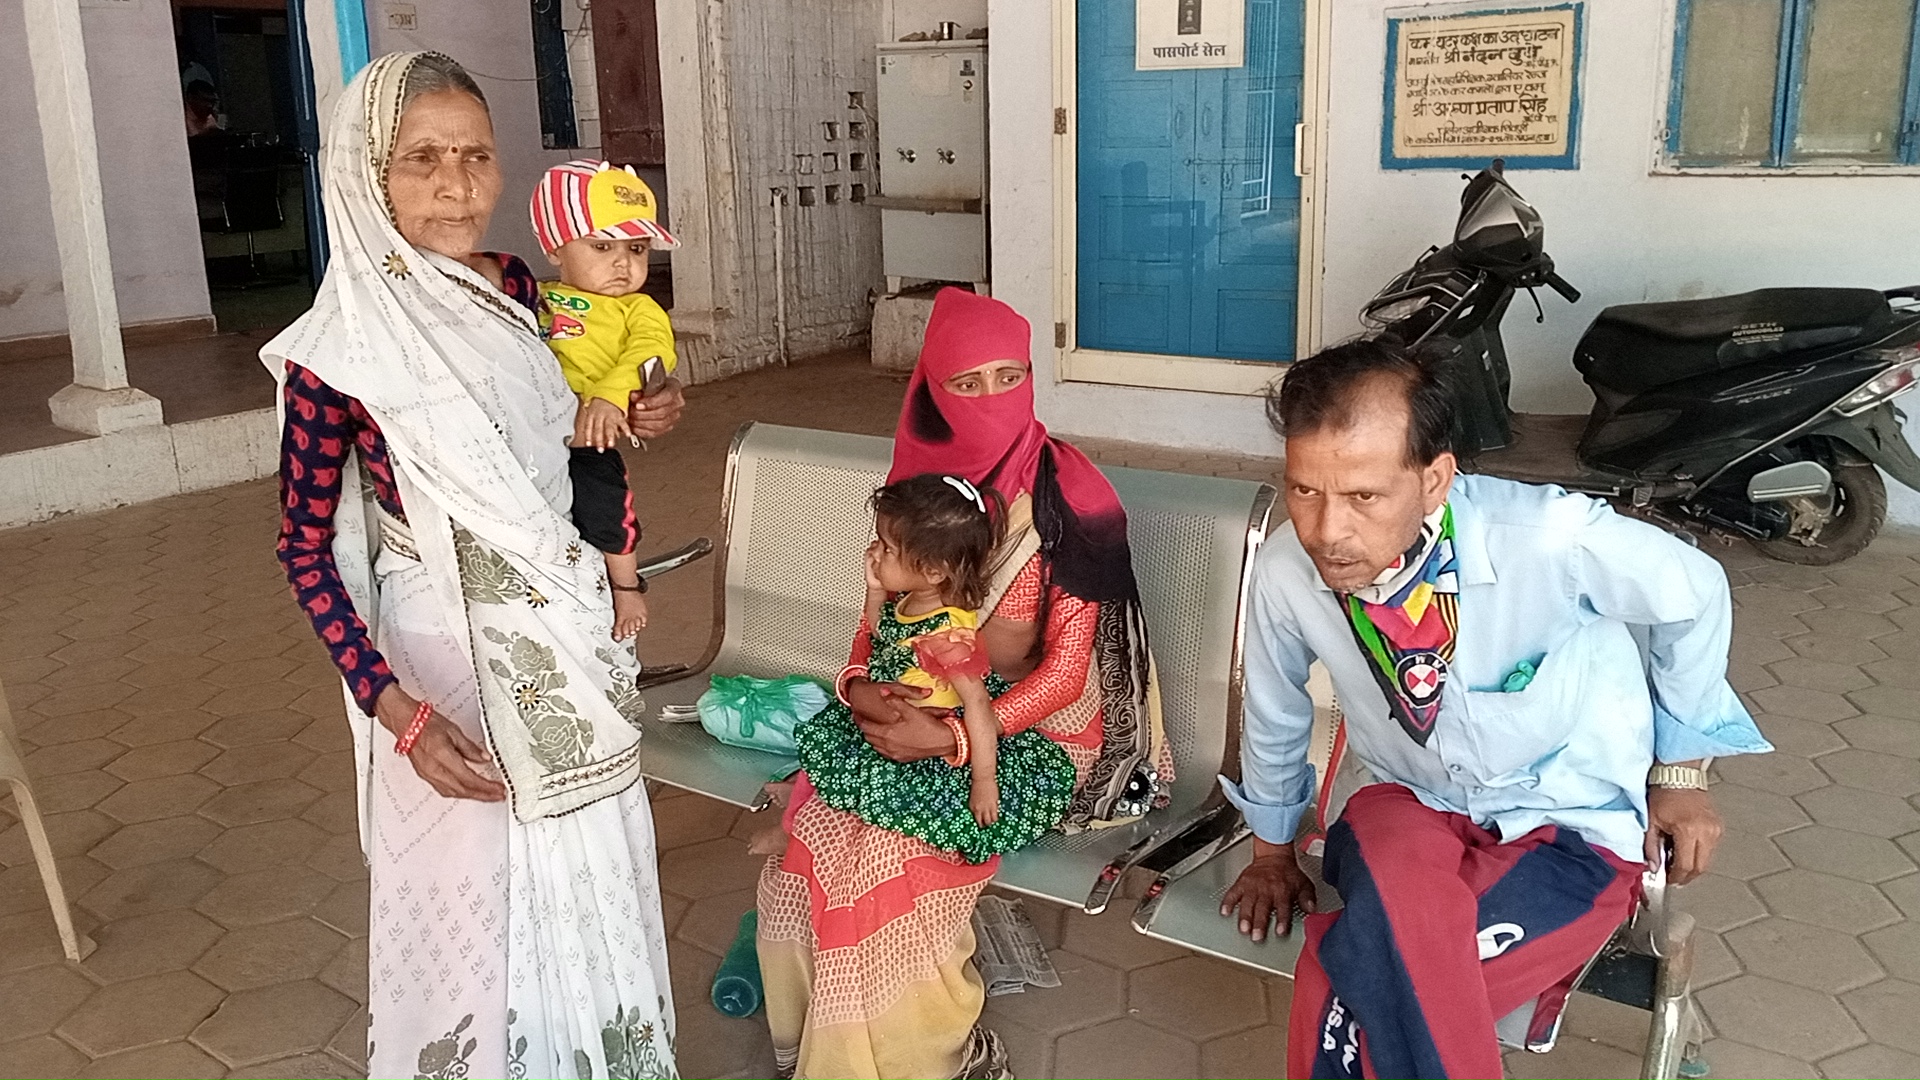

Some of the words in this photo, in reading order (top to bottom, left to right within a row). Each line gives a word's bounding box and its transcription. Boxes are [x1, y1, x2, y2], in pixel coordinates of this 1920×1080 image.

[1152, 42, 1199, 58] पासपोर्ट
[1202, 42, 1227, 56] सेल
[1444, 47, 1461, 64] श्री
[1475, 100, 1519, 117] प्रताप
[1519, 91, 1549, 116] सिंह
